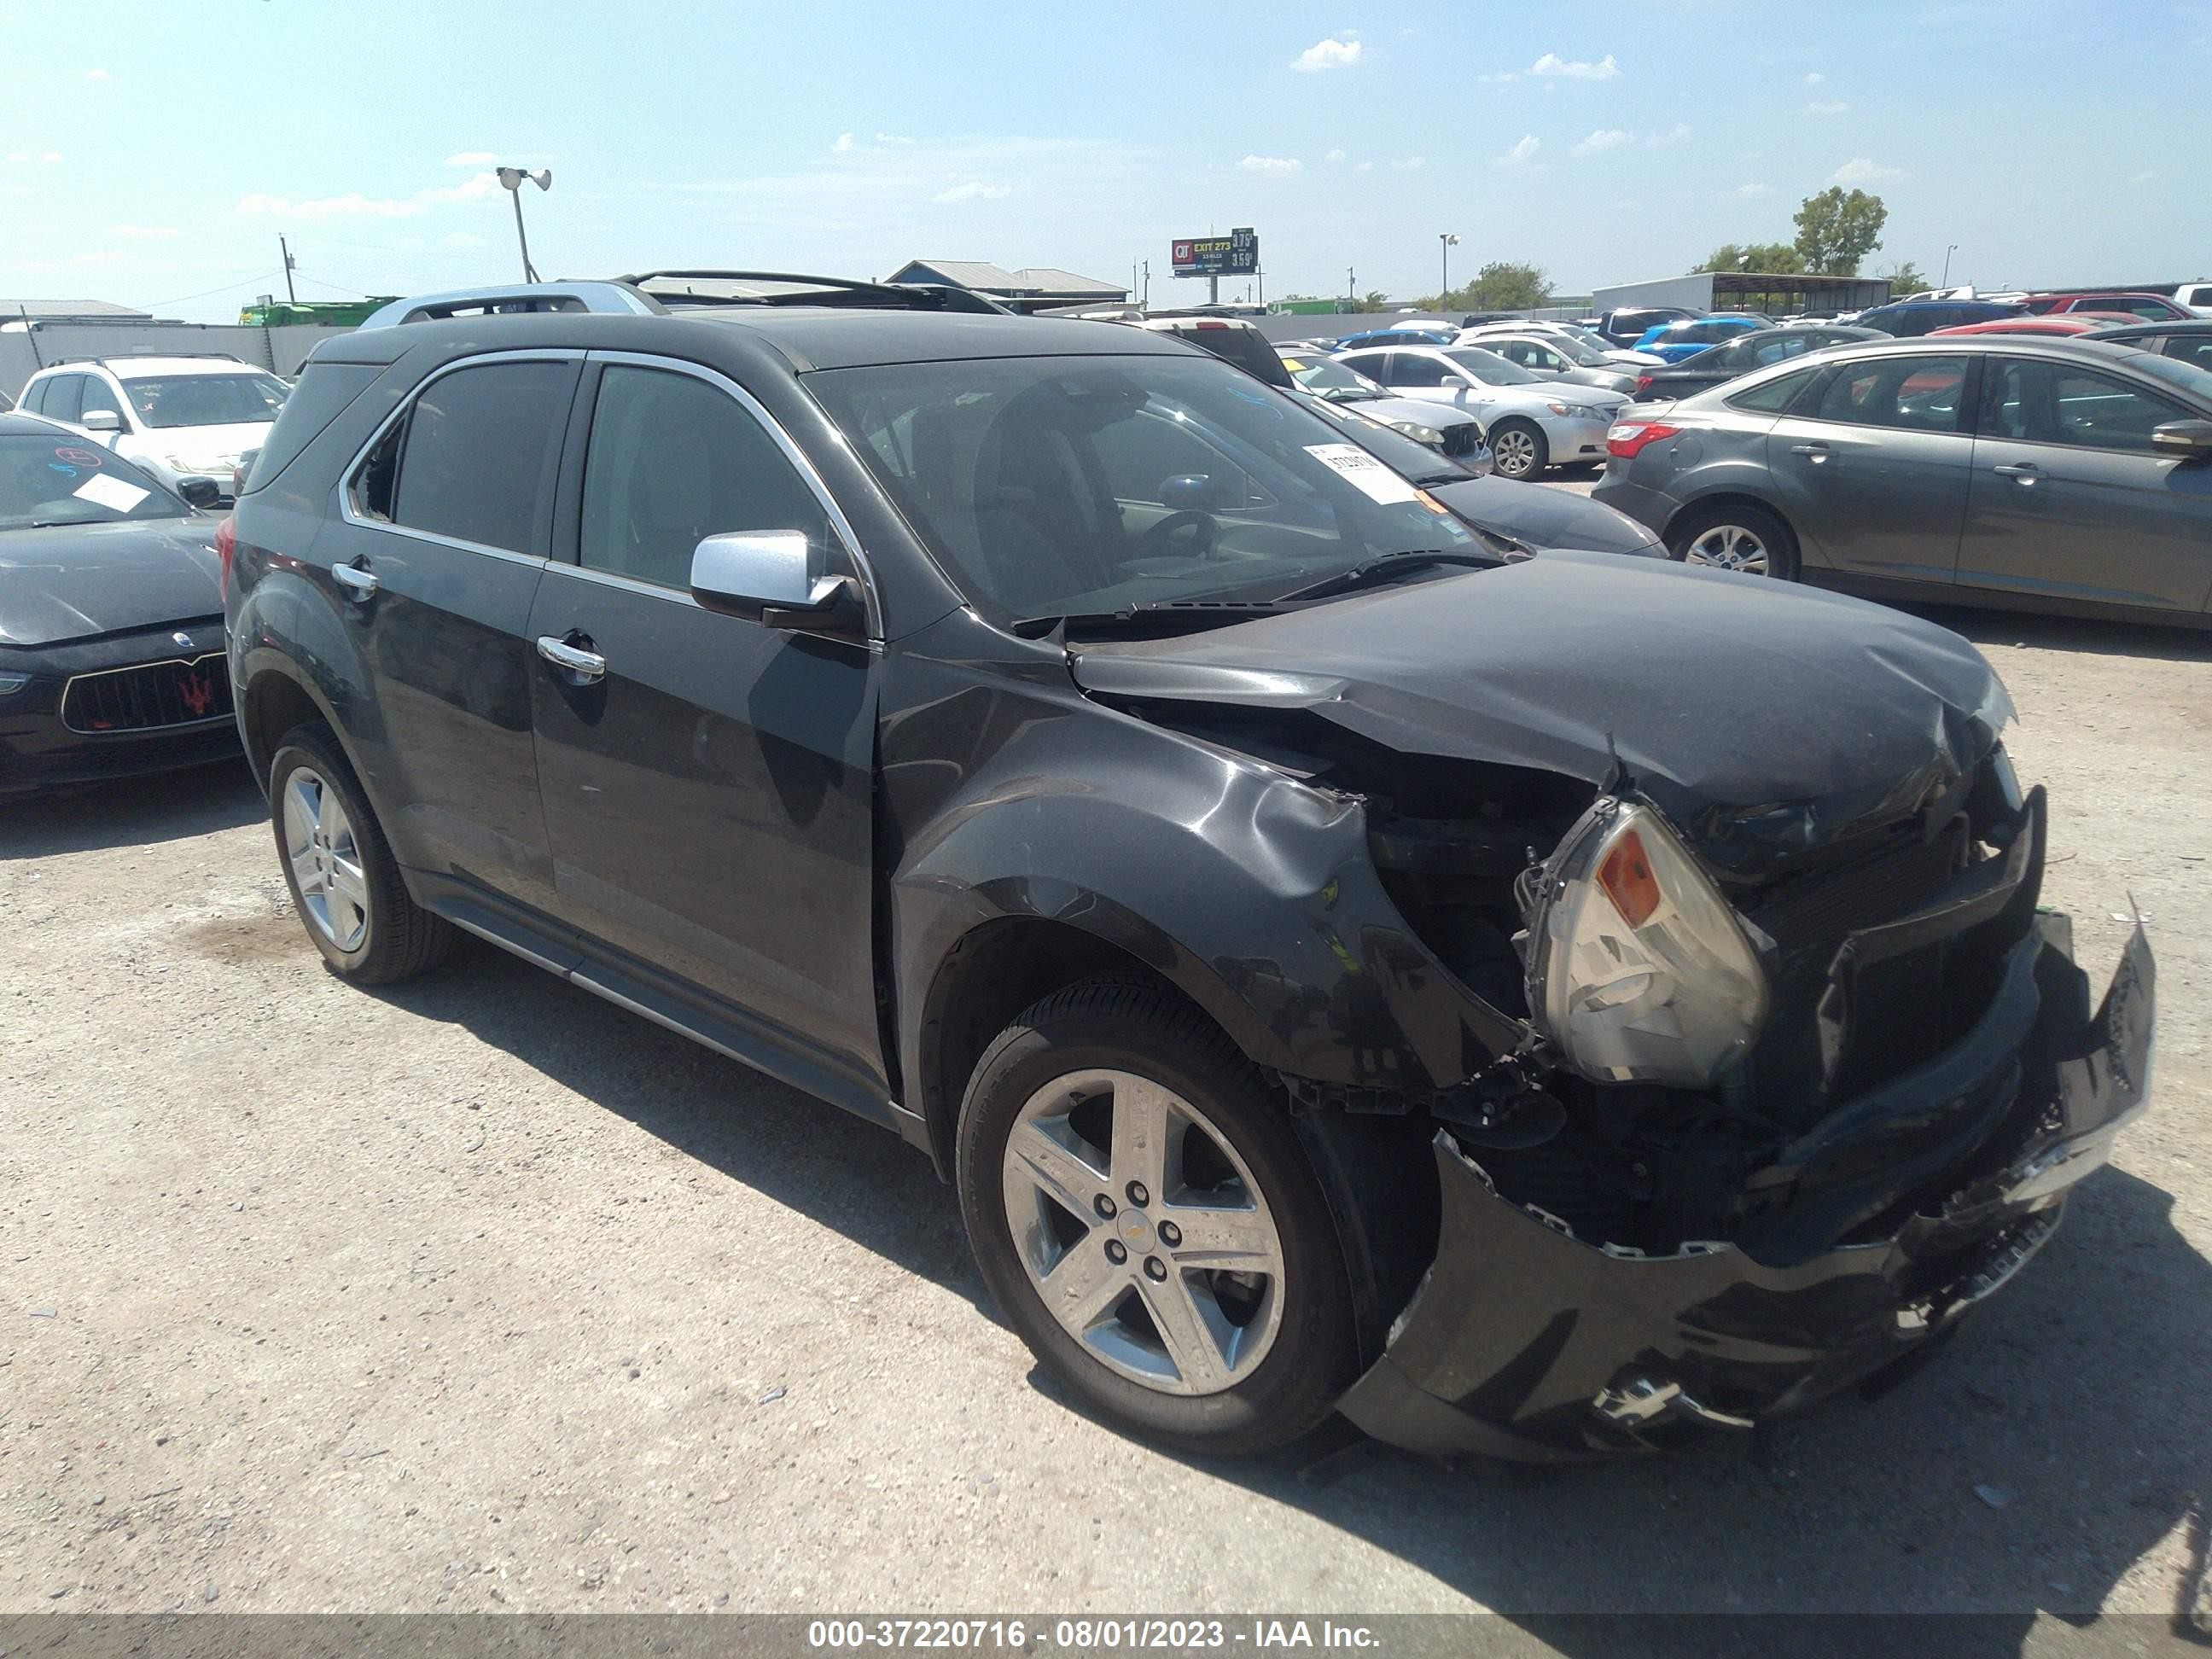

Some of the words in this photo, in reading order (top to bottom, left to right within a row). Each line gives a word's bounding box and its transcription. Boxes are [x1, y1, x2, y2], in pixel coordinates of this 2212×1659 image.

[1175, 245, 1190, 259] QT
[1194, 242, 1212, 253] EXIT
[1214, 242, 1231, 251] 273
